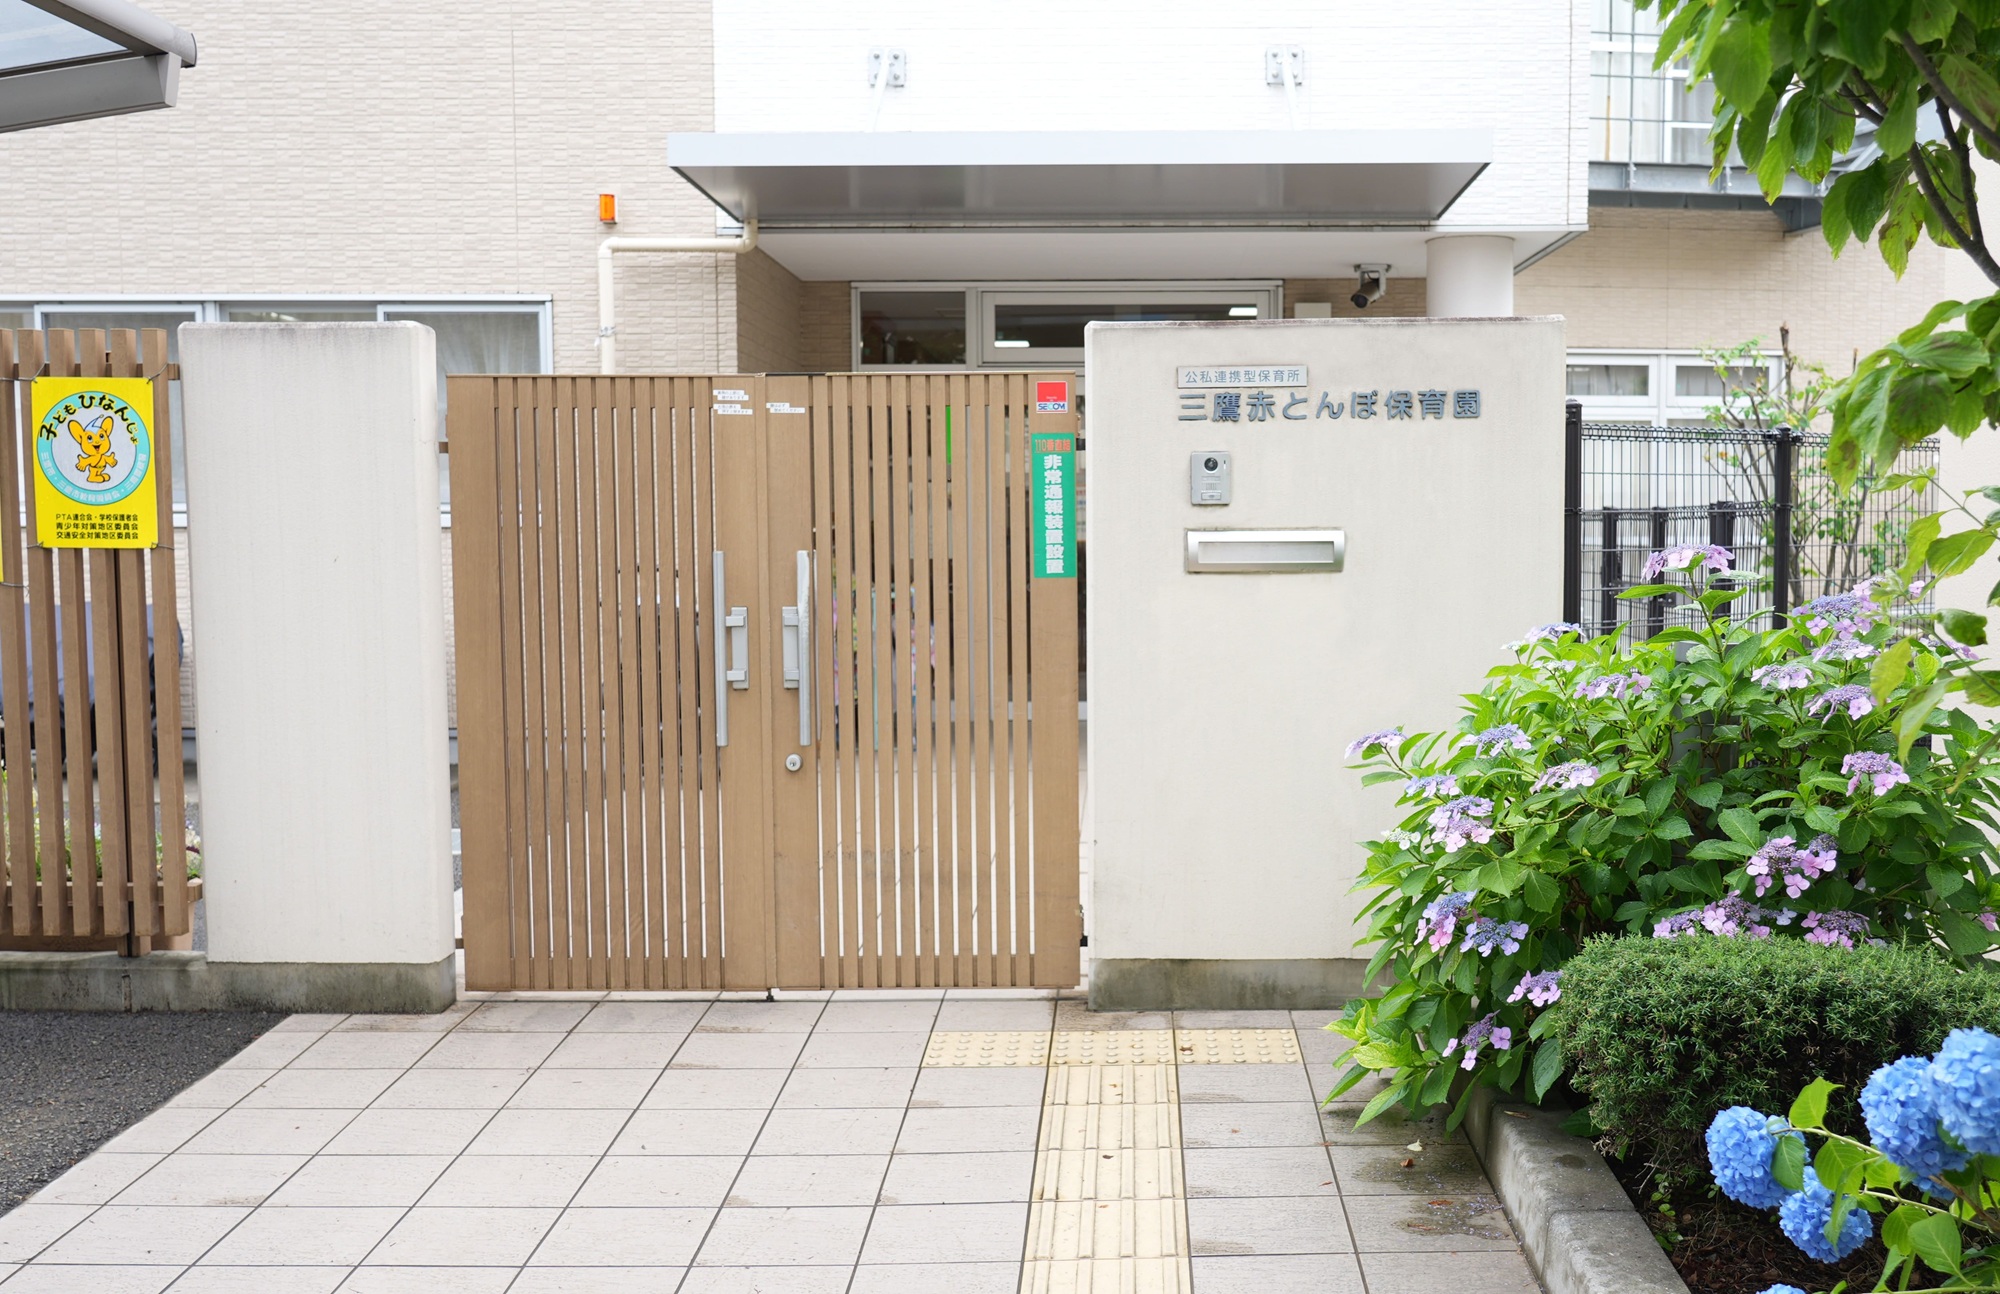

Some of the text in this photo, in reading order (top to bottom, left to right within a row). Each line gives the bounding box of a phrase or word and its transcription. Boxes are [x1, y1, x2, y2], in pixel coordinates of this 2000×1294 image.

[1185, 369, 1300, 384] 公私連携型保育所
[1037, 402, 1066, 411] SECOM
[1178, 389, 1482, 423] 三鷹赤とんぼ保育園
[1043, 454, 1065, 574] 非常通報装置設置
[56, 522, 139, 531] 青少年対策地区委員会
[56, 531, 139, 540] 交通安全対策地区委員会
